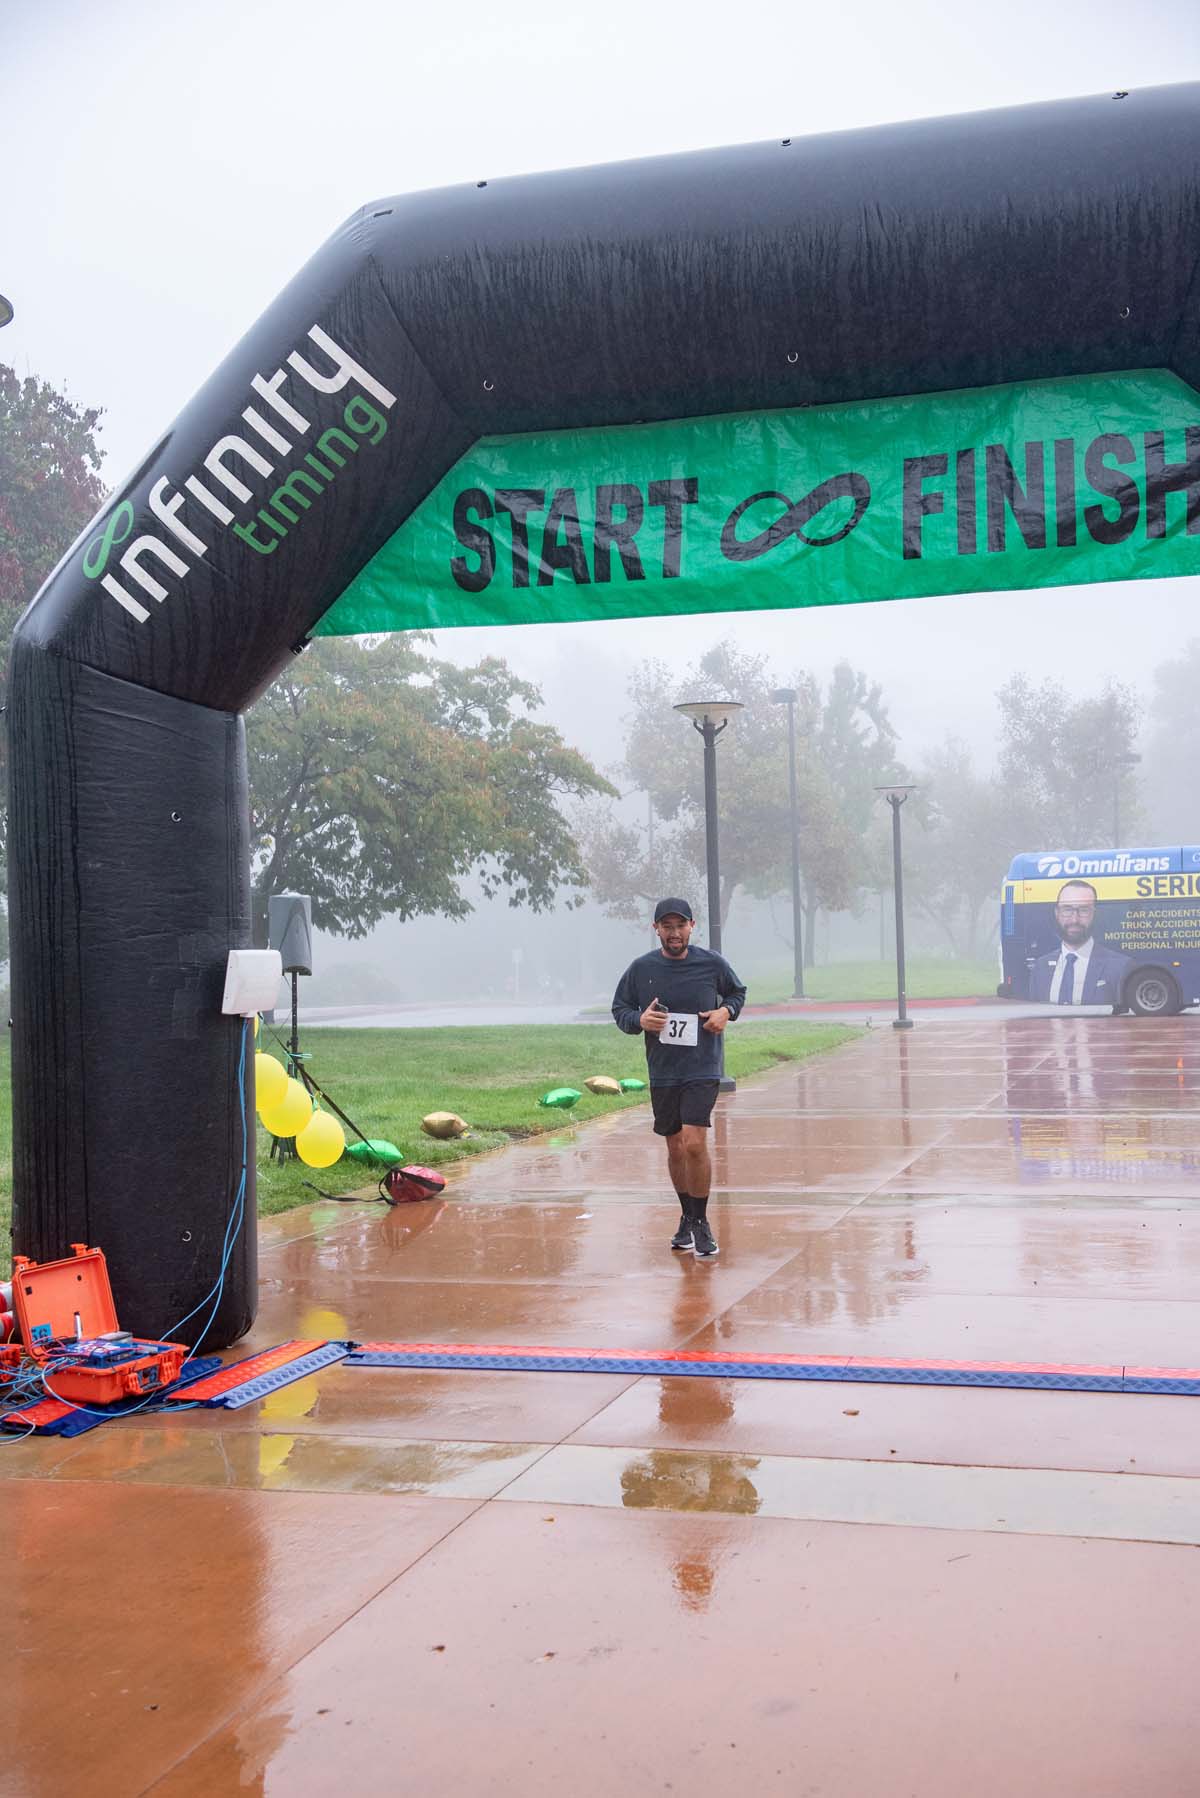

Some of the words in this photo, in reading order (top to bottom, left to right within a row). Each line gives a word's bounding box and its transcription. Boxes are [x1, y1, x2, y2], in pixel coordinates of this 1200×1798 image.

[101, 324, 397, 623] infinity
[232, 395, 388, 554] timing
[451, 477, 698, 592] START
[903, 426, 1200, 560] FINISH
[1063, 853, 1169, 874] OmniTrans
[1136, 875, 1200, 897] SERI
[1126, 910, 1146, 918] CAR
[1120, 921, 1152, 929] TRUCK
[1104, 930, 1169, 940] MOTORCYCLE
[1121, 941, 1173, 950] PERSONAL
[669, 1020, 687, 1038] 37
